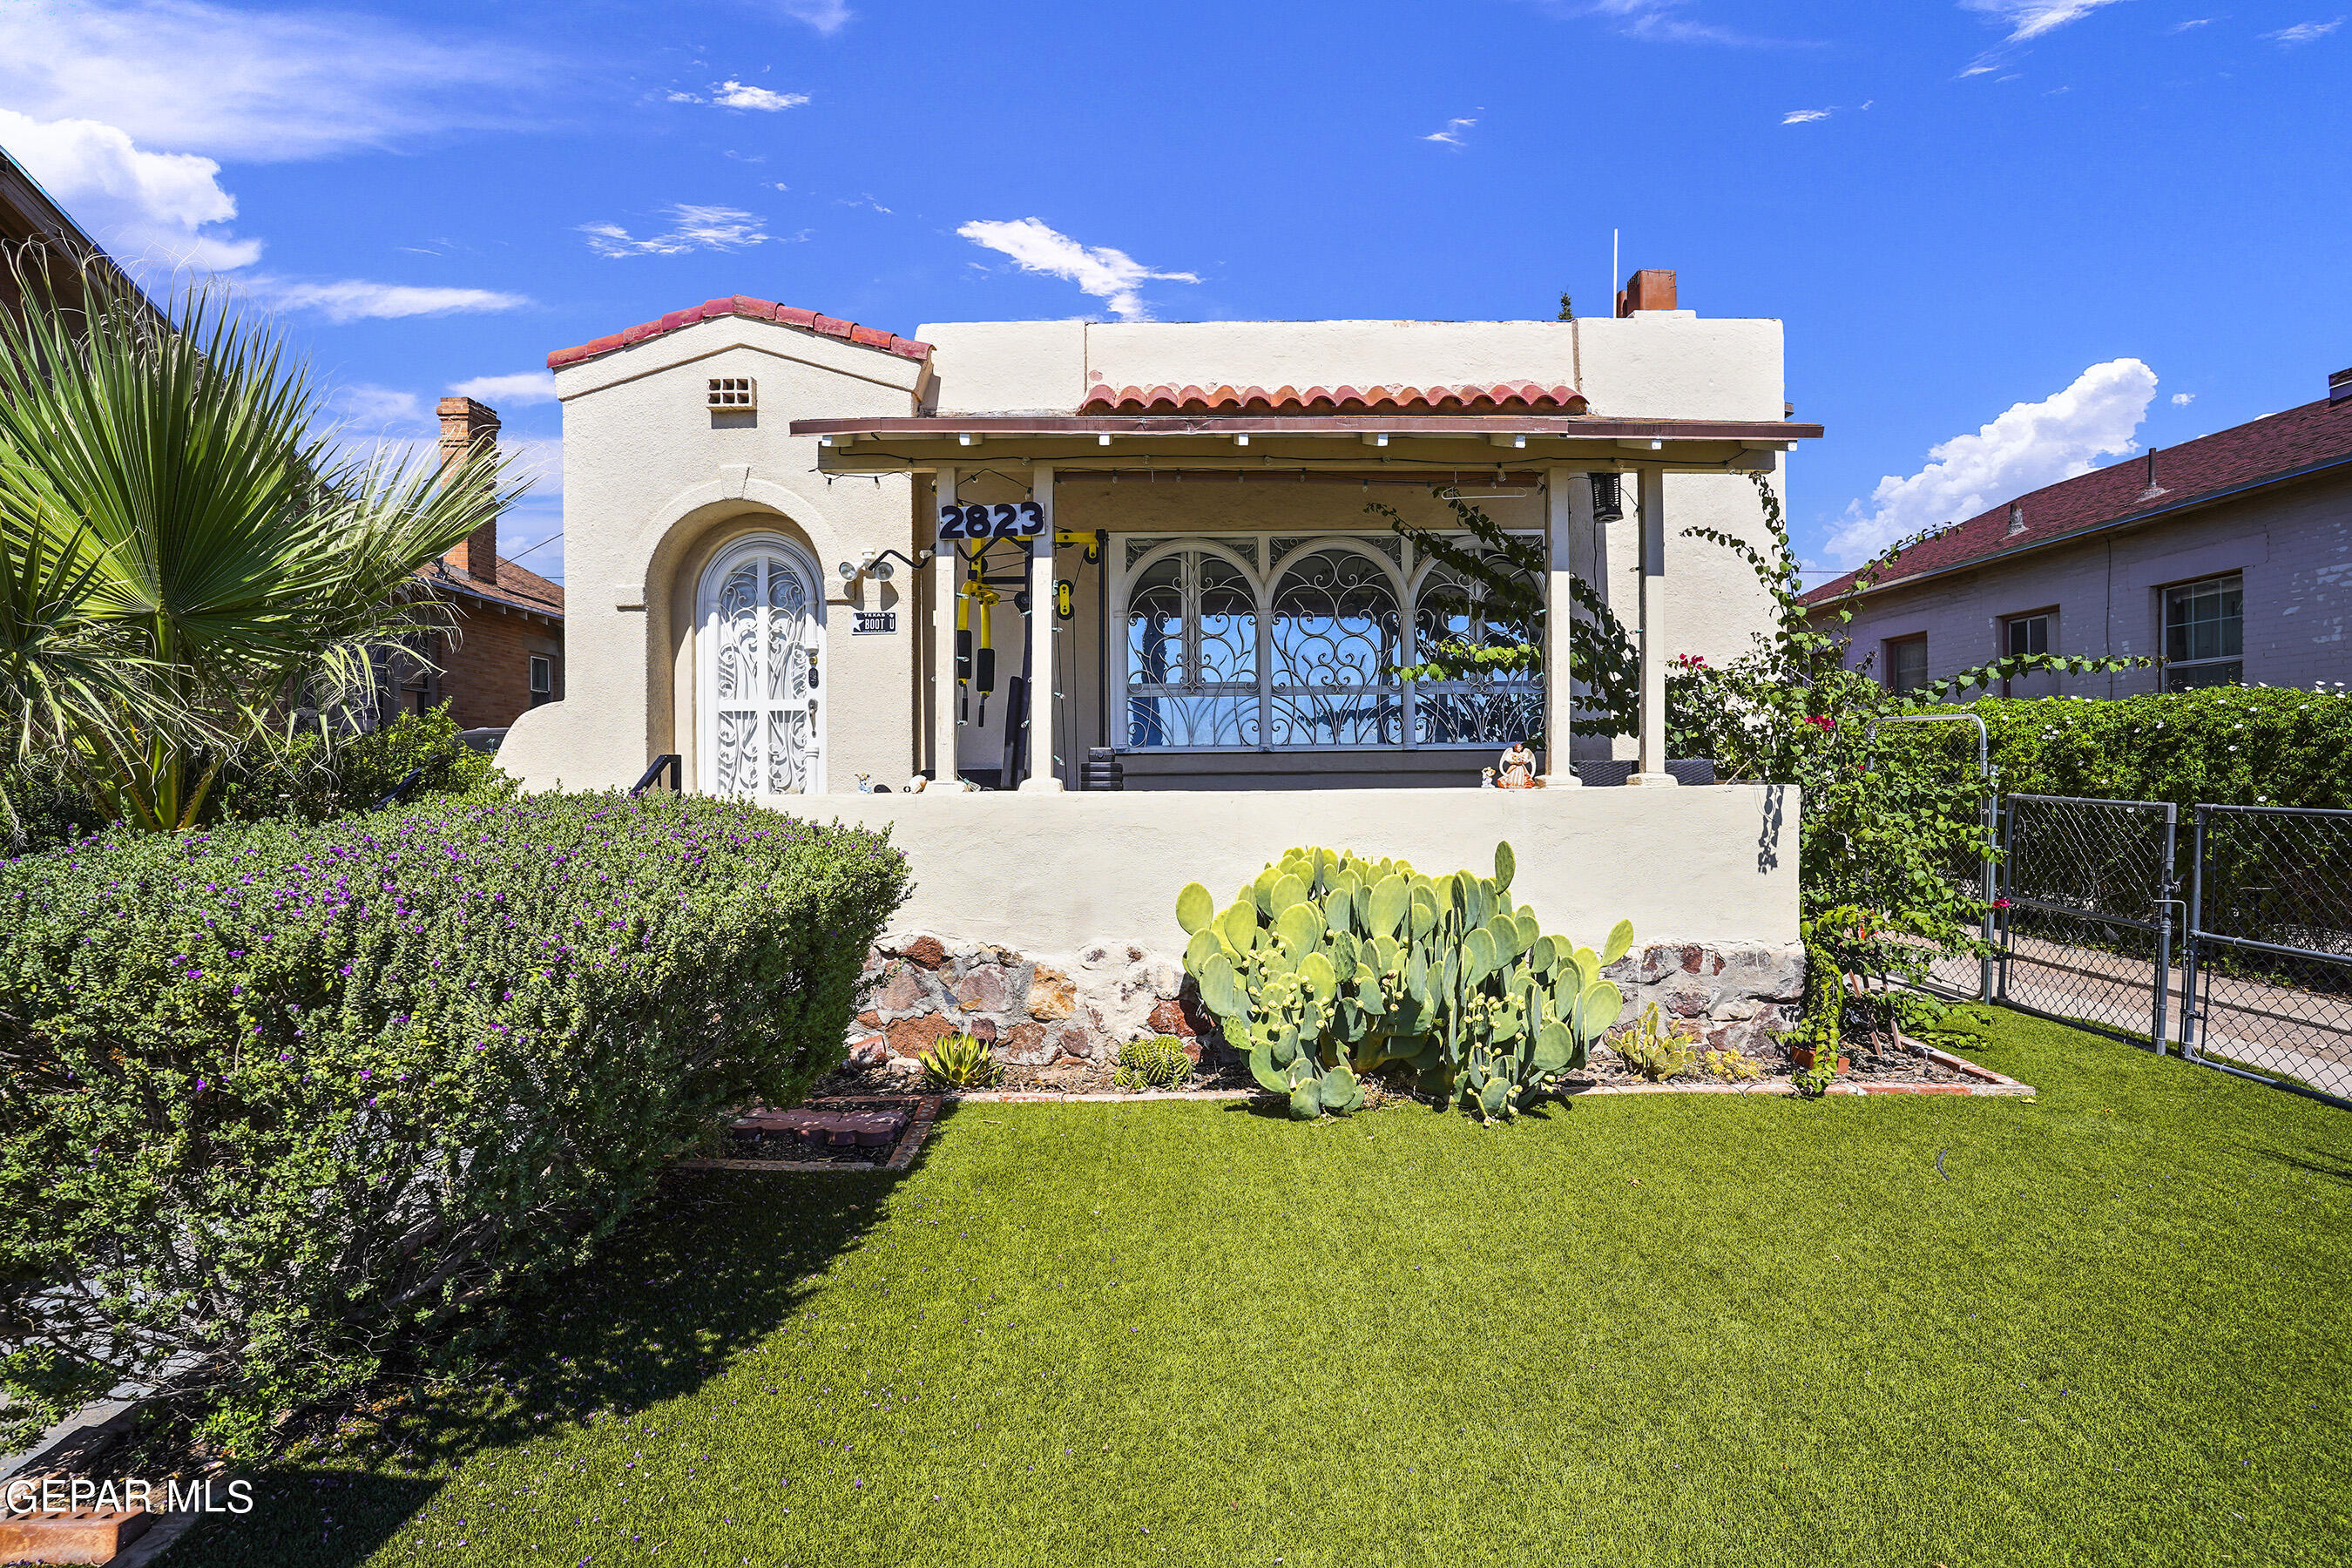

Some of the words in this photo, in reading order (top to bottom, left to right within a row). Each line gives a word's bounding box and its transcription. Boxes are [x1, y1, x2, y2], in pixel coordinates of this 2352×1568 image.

[939, 501, 1044, 539] 2823
[865, 618, 885, 630] BOOT
[889, 618, 895, 629] U
